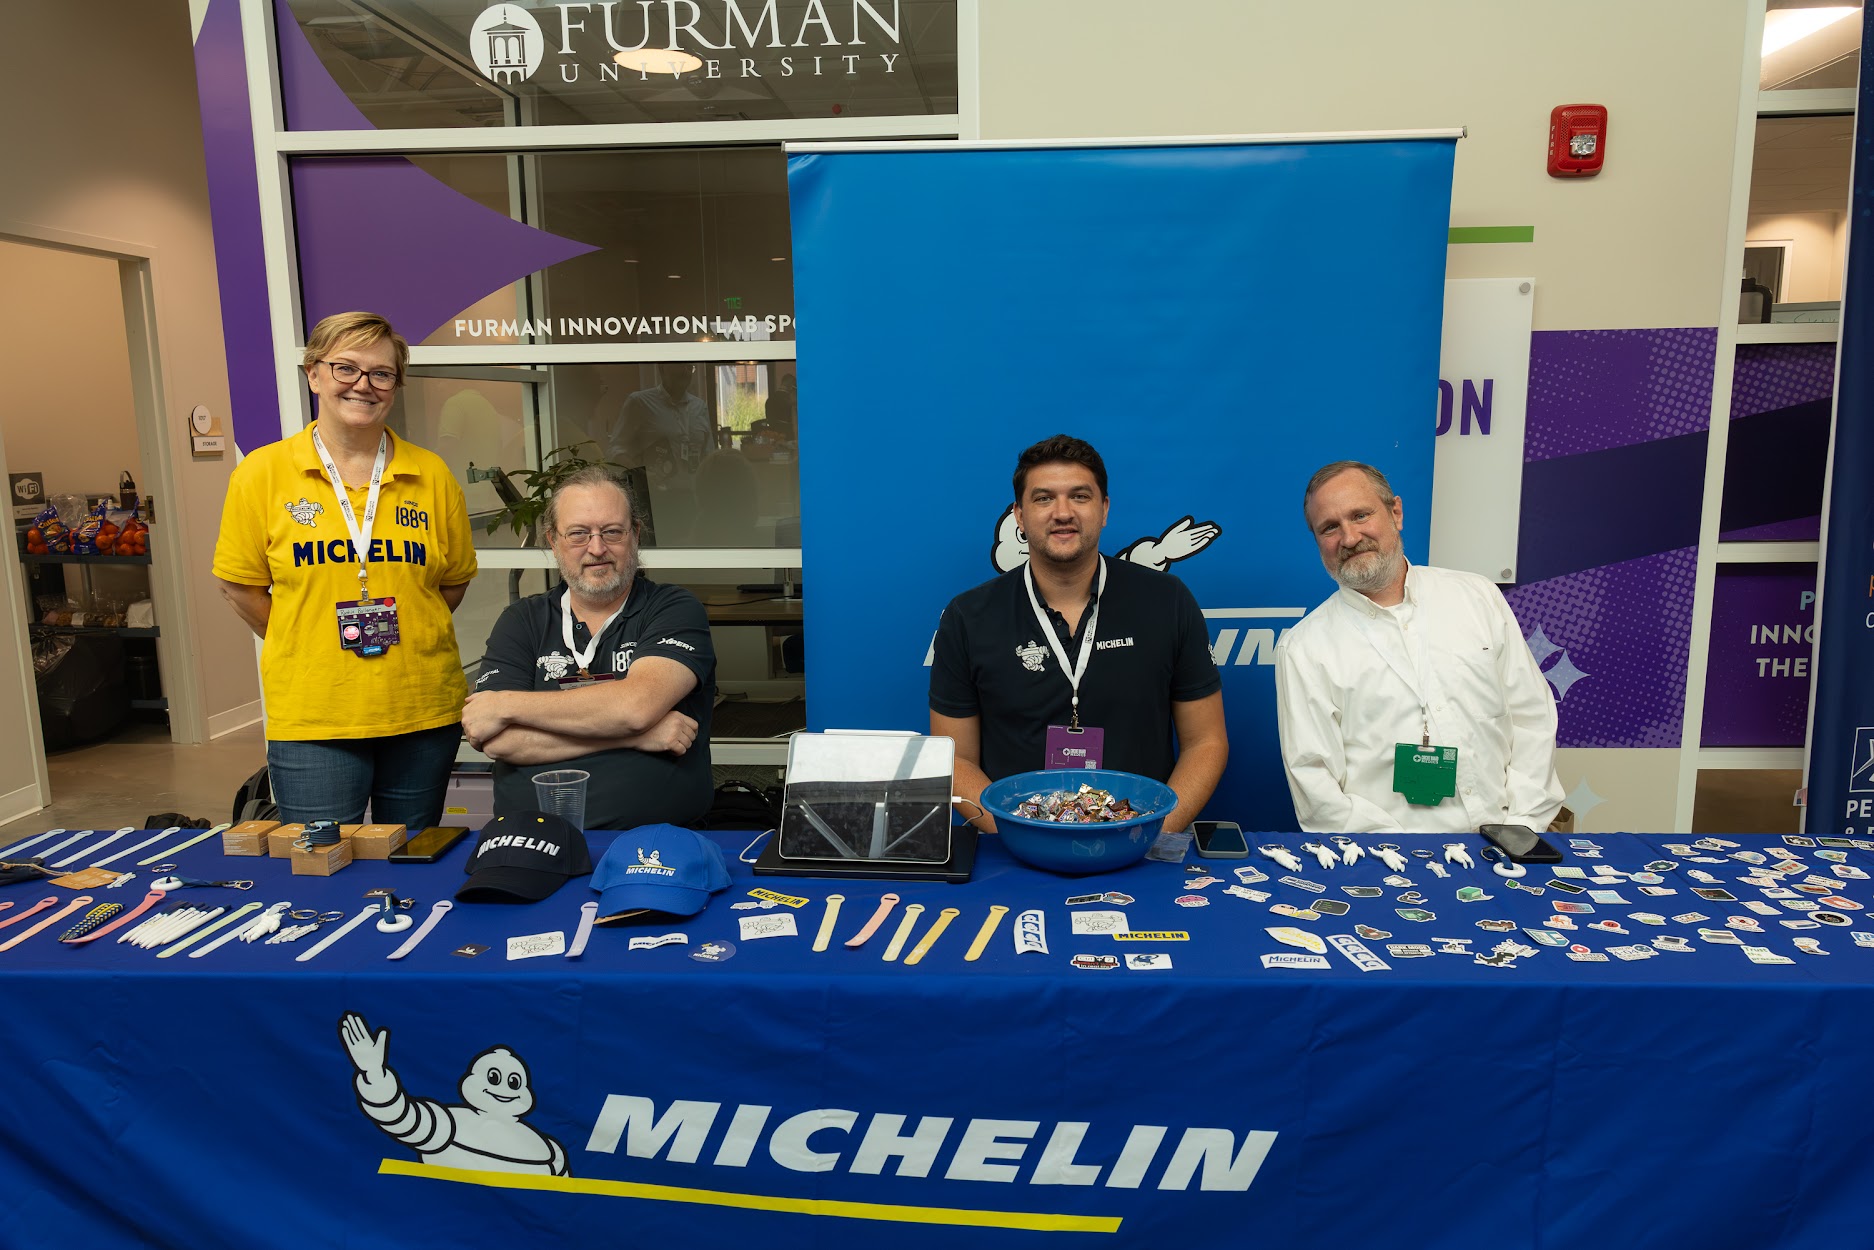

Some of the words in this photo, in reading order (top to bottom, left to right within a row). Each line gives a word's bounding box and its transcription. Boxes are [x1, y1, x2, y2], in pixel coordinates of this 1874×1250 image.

[556, 0, 899, 54] FURMAN
[560, 54, 899, 83] UNIVERSITY
[455, 318, 552, 337] FURMAN
[560, 315, 708, 336] INNOVATION
[716, 315, 758, 334] LAB
[764, 314, 796, 333] SP
[395, 505, 429, 531] 1889
[293, 538, 426, 567] MICHELIN
[1096, 637, 1134, 650] MICHELIN
[1756, 657, 1809, 678] THE
[476, 834, 561, 859] MICHELIN
[625, 867, 675, 877] MICHELIN
[752, 889, 805, 907] MICHELIN
[1118, 932, 1185, 940] MICHELIN
[1268, 955, 1321, 964] MICHELIN
[584, 1094, 1279, 1193] MICHELIN
